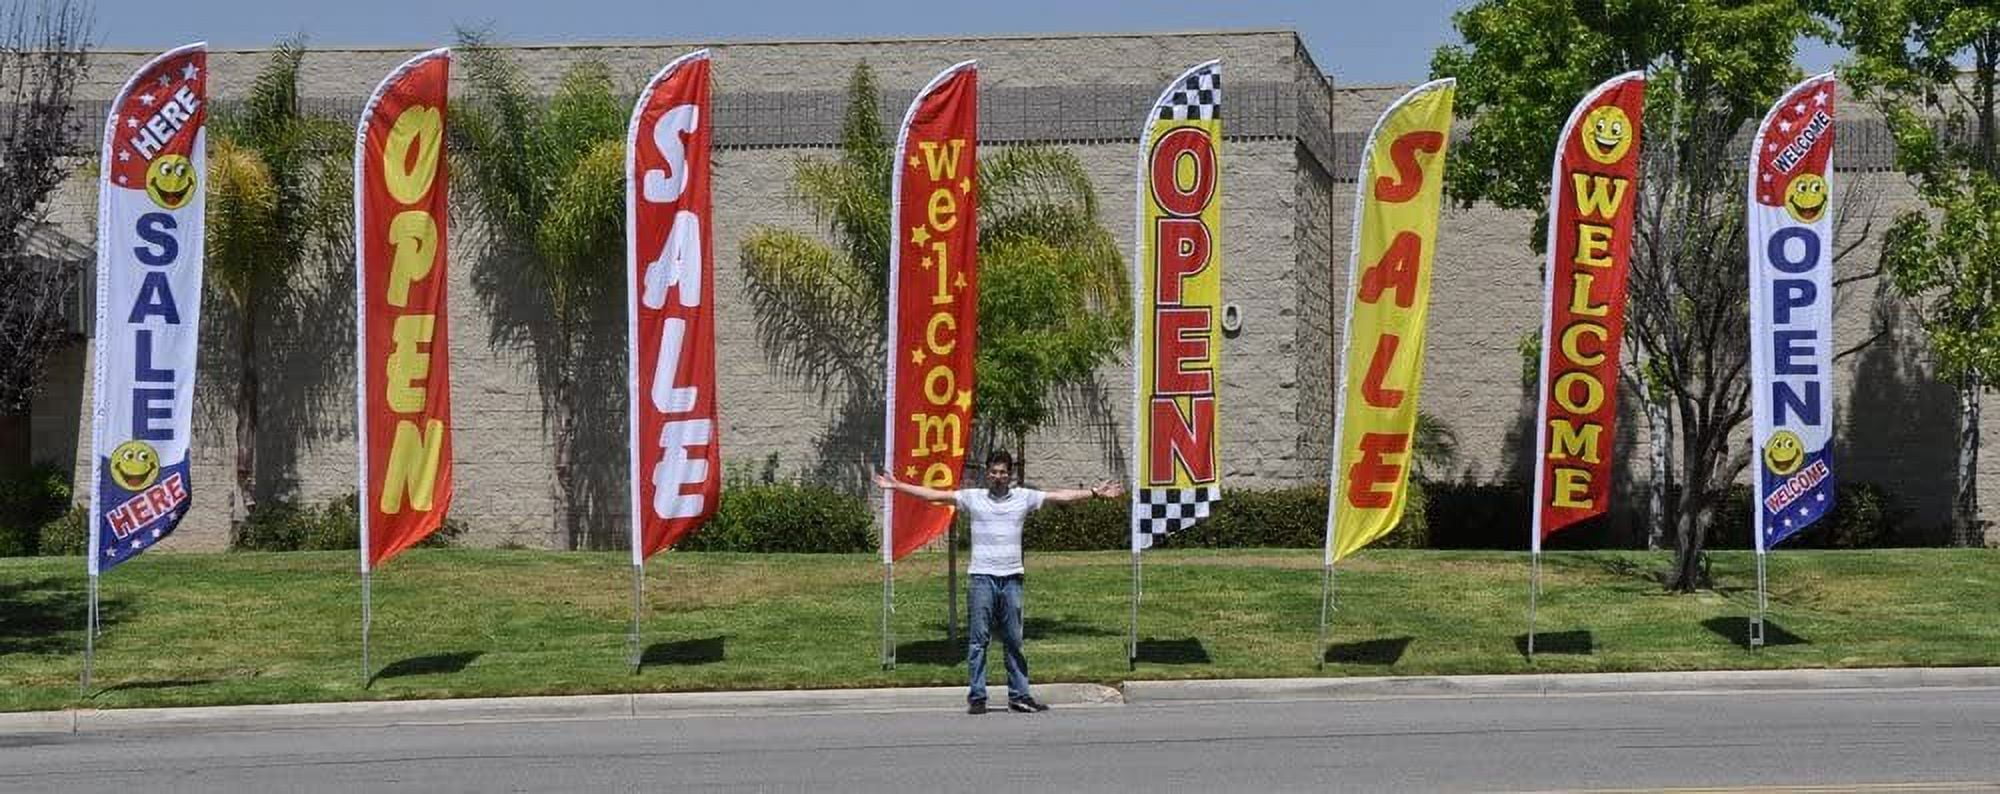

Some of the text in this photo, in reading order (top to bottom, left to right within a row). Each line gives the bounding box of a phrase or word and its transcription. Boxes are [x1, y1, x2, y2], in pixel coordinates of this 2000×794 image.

[129, 84, 199, 161] HERE
[1770, 109, 1832, 175] WELCOME
[128, 211, 181, 441] SALE
[380, 104, 445, 515] OPEN
[642, 103, 713, 520] SALE
[1149, 125, 1218, 486] OPEN
[1347, 129, 1444, 510] SALE
[1547, 172, 1630, 511] WELCOME
[1766, 226, 1822, 428] OPEN
[106, 472, 187, 540] HERE
[1763, 459, 1830, 515] WELCOME
